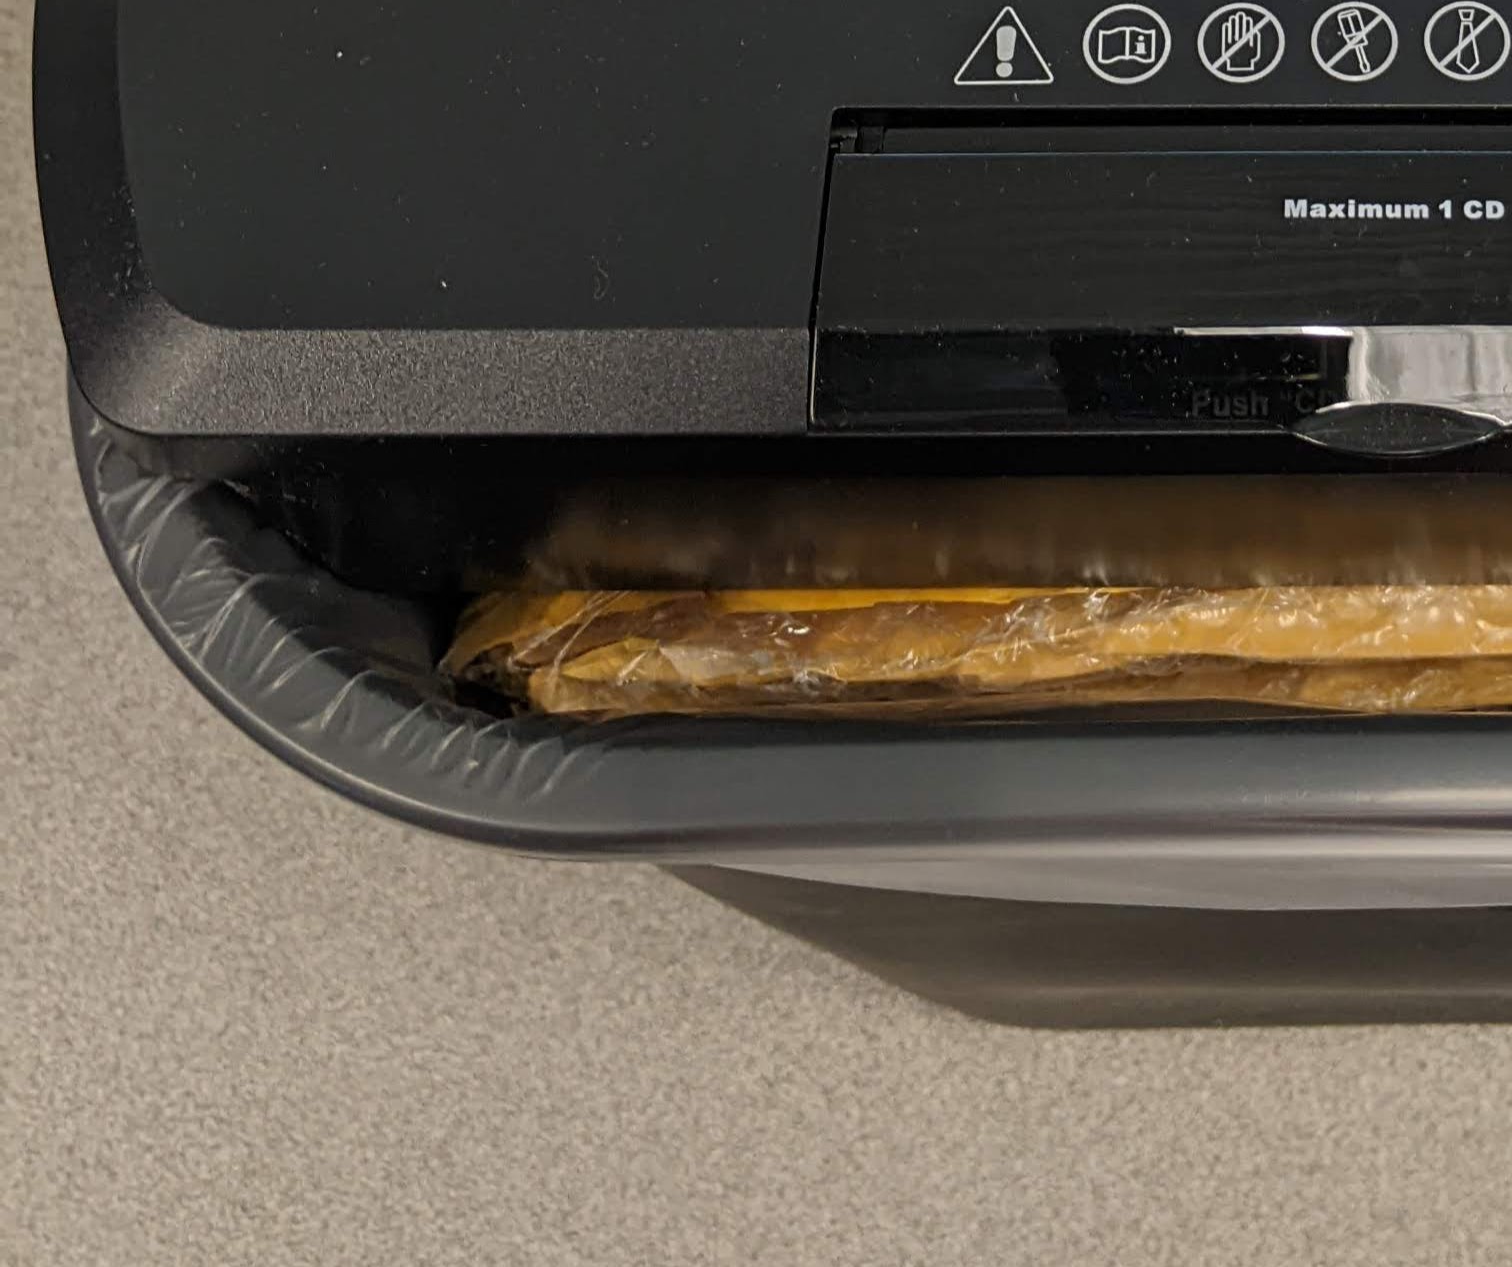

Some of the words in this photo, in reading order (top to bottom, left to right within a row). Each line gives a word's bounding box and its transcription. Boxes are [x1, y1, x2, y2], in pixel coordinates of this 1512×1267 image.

[1285, 199, 1429, 218] Maximum
[1439, 200, 1451, 218] 1
[1464, 200, 1504, 219] CD
